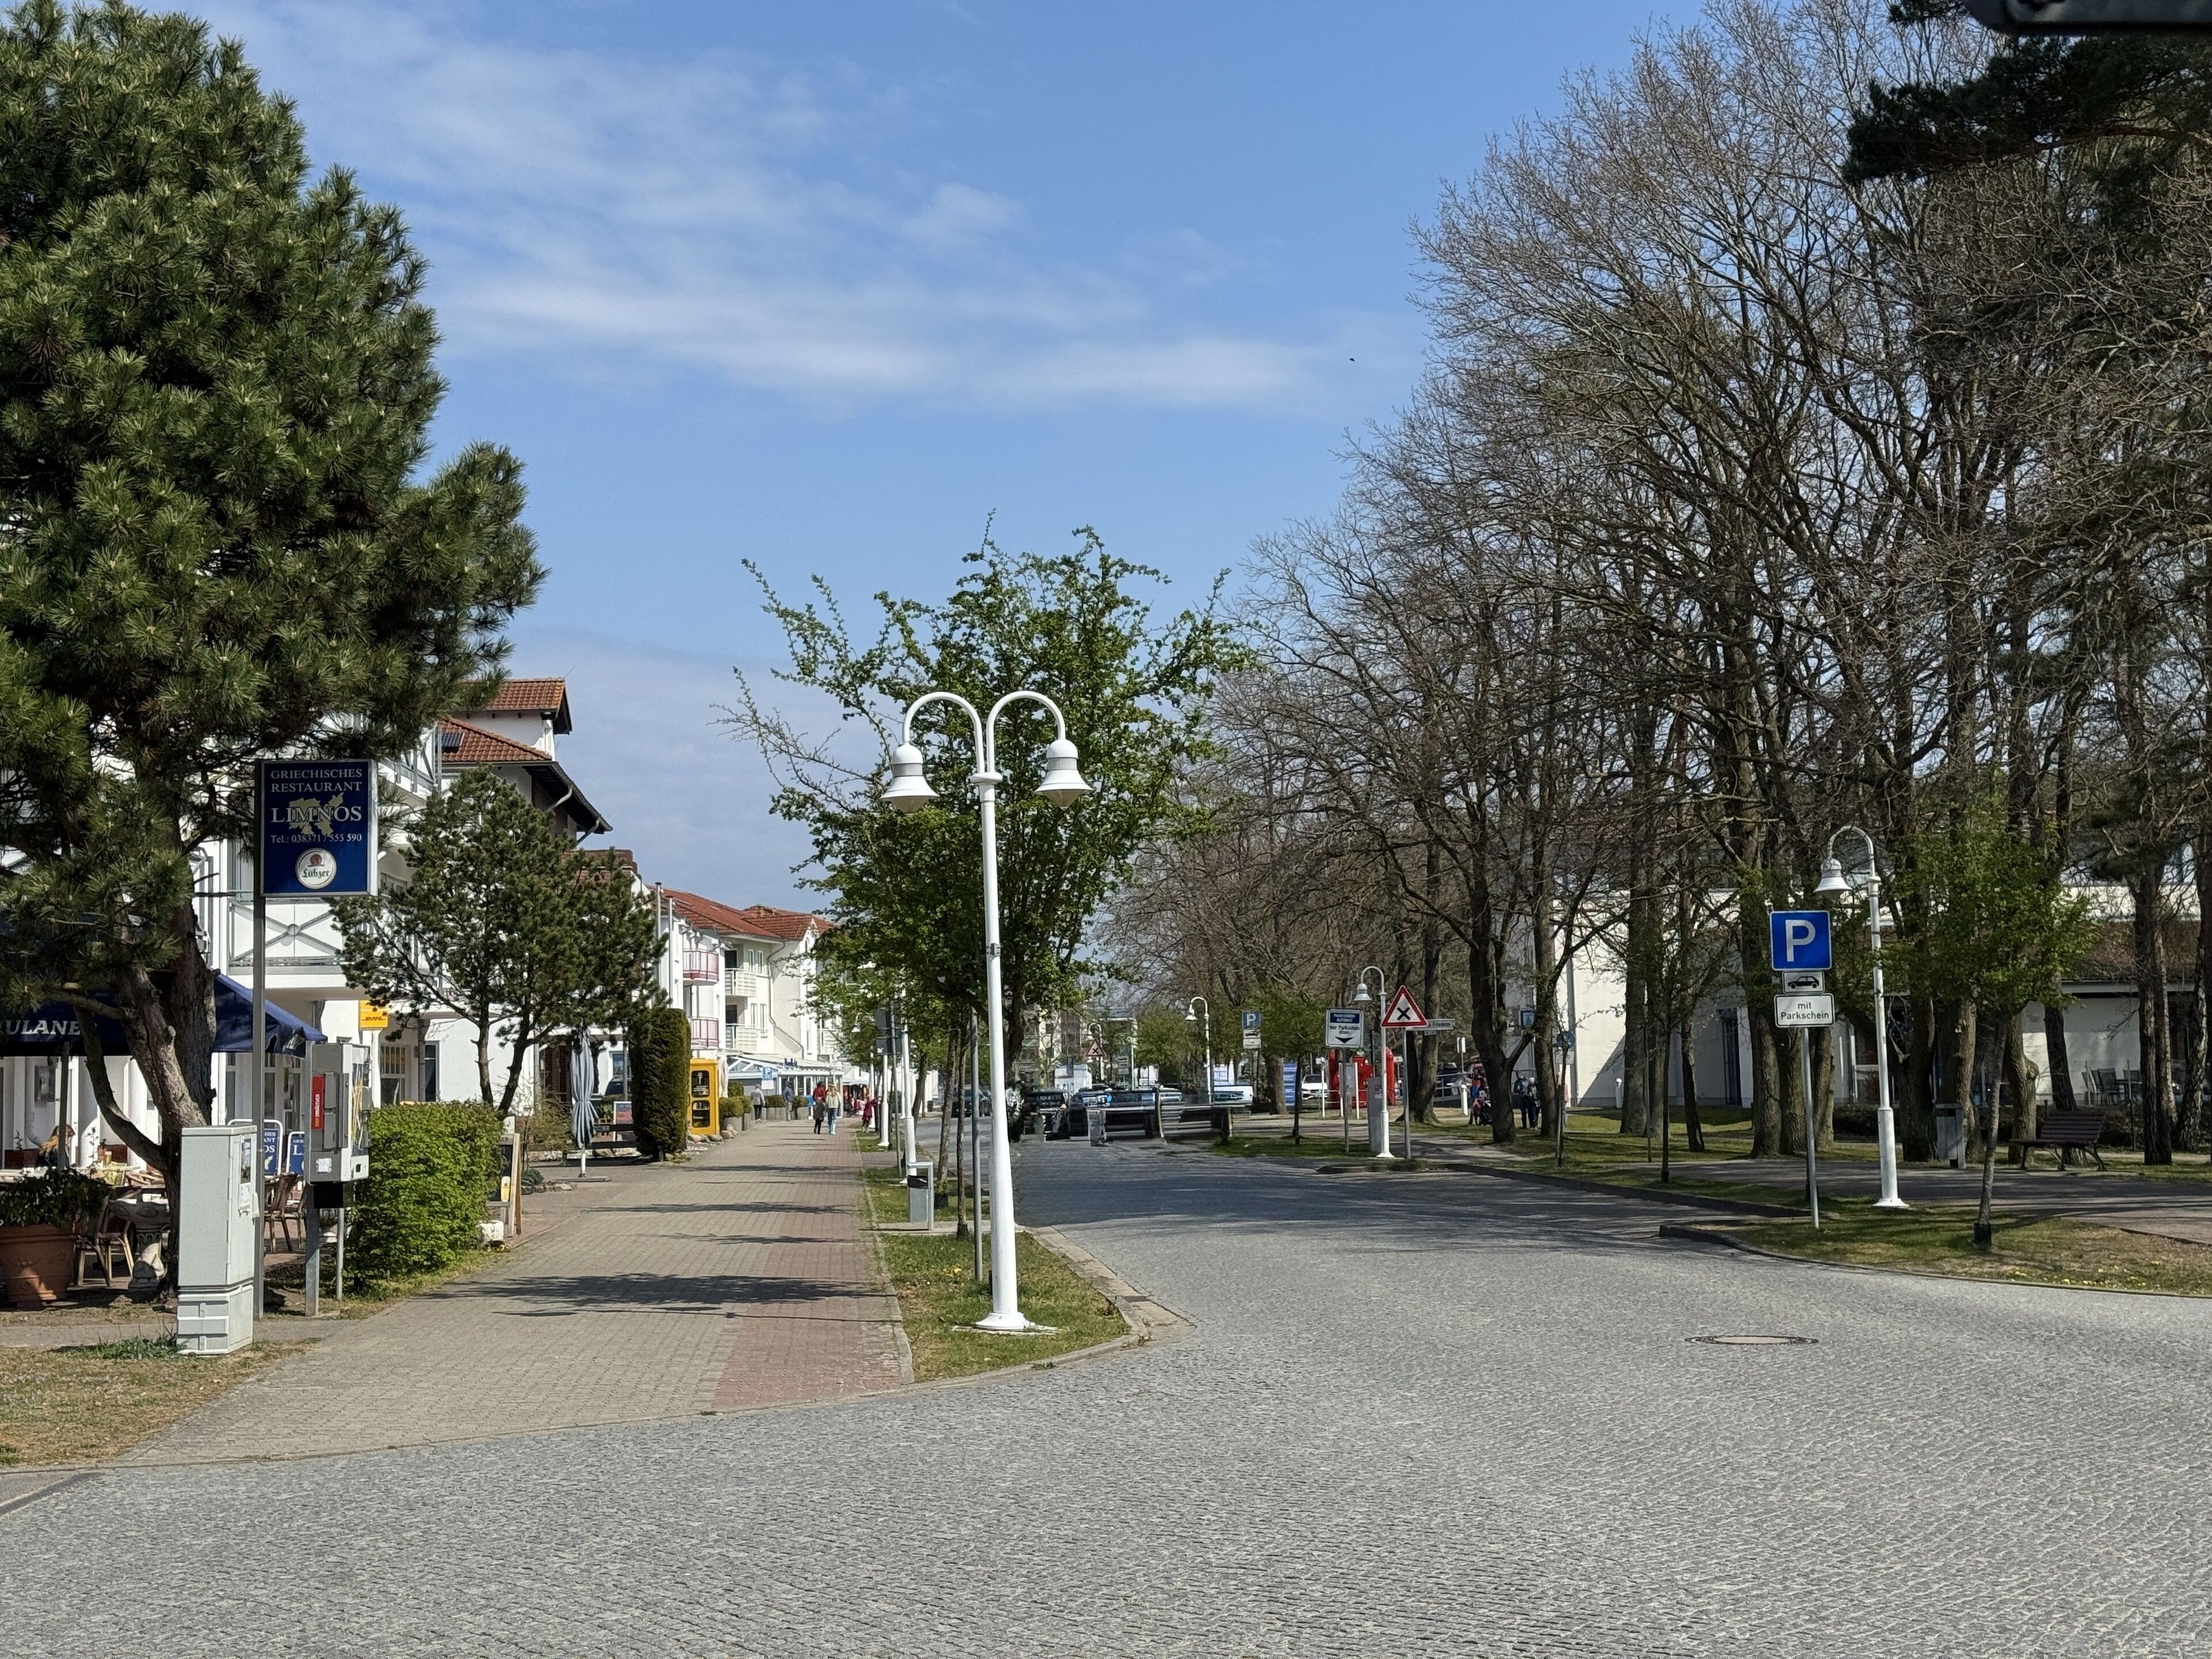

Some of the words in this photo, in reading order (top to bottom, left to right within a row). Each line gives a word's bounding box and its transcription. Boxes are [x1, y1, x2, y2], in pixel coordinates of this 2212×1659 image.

[271, 768, 362, 779] GRIECHISCHES
[271, 782, 362, 793] RESTAURANT
[271, 806, 362, 823] LIMNOS
[271, 835, 289, 843] Tel.:
[291, 835, 321, 843] 038371
[323, 835, 327, 843] /
[329, 834, 344, 842] 555
[346, 834, 362, 842] 590
[302, 868, 330, 878] Lübzer
[1786, 919, 1816, 962] P
[1797, 1001, 1812, 1010] mit
[1247, 1013, 1256, 1026] P
[1781, 1011, 1830, 1020] Parkschein
[5, 1020, 82, 1035] ULANE
